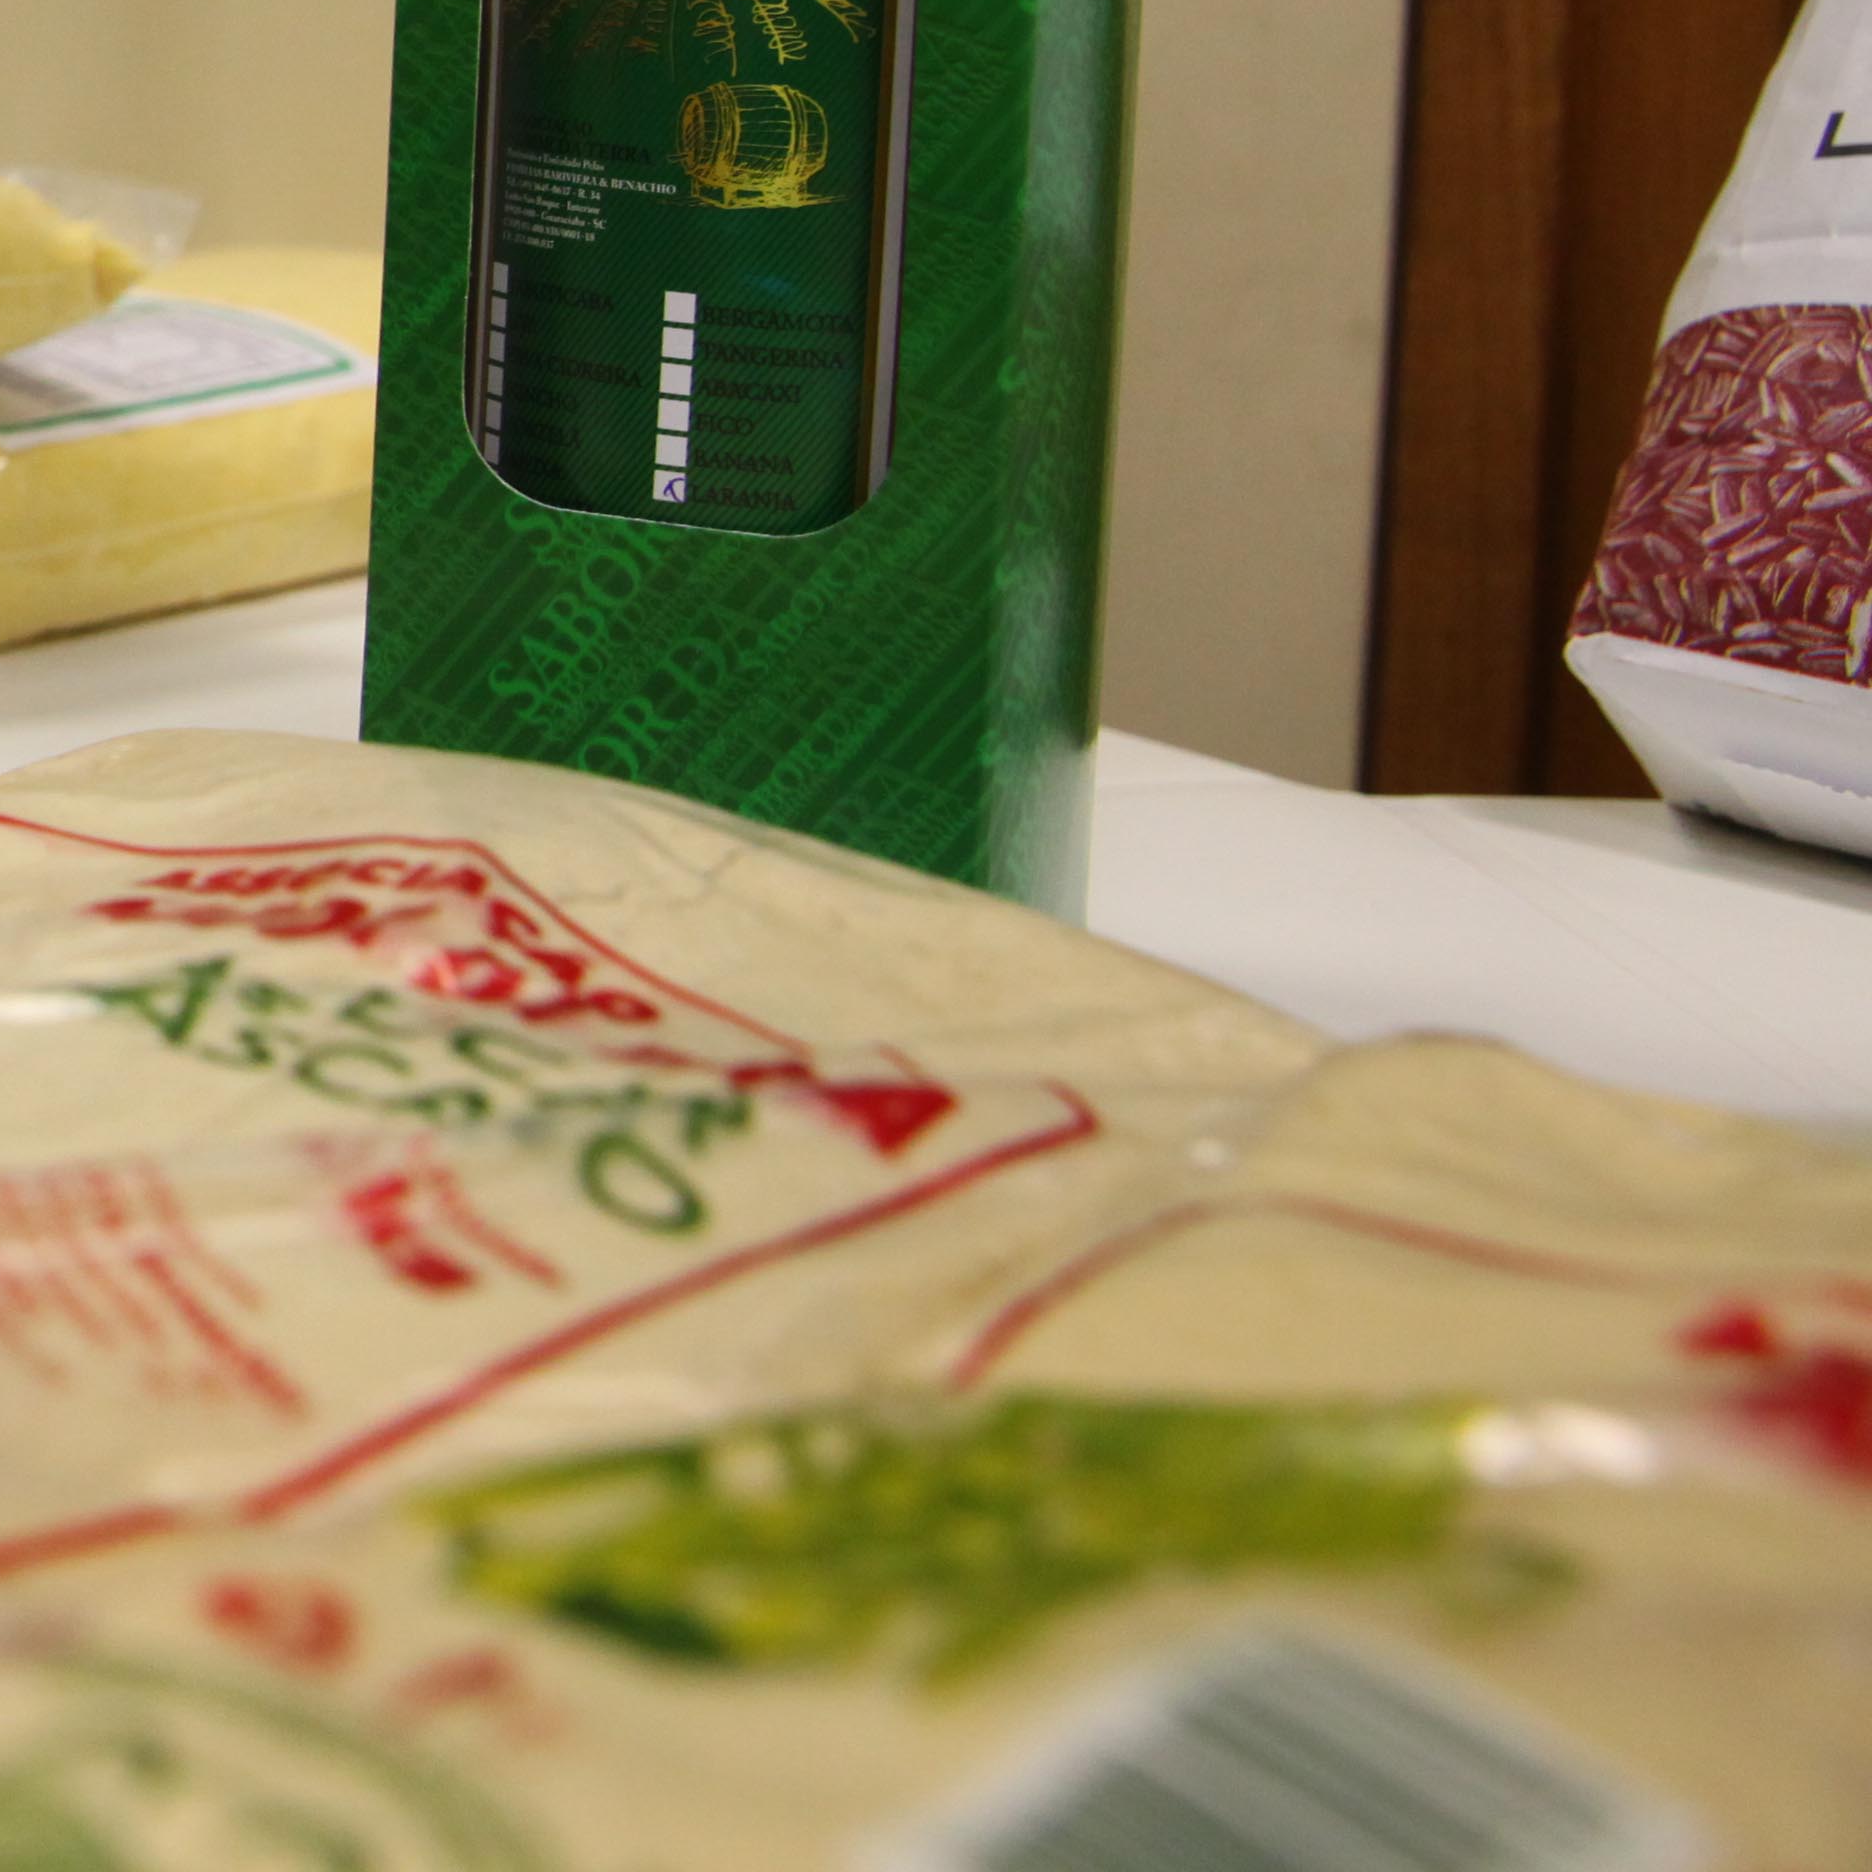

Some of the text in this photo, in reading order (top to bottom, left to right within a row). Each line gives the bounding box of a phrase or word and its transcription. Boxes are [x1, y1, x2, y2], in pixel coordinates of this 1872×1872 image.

[611, 178, 677, 195] BENACHIO
[703, 304, 855, 334] BERGAMOTA
[701, 342, 846, 370] TANGERINA
[698, 378, 803, 405] ABACAXI
[694, 449, 795, 476] BANANA
[691, 484, 797, 513] LARANJA
